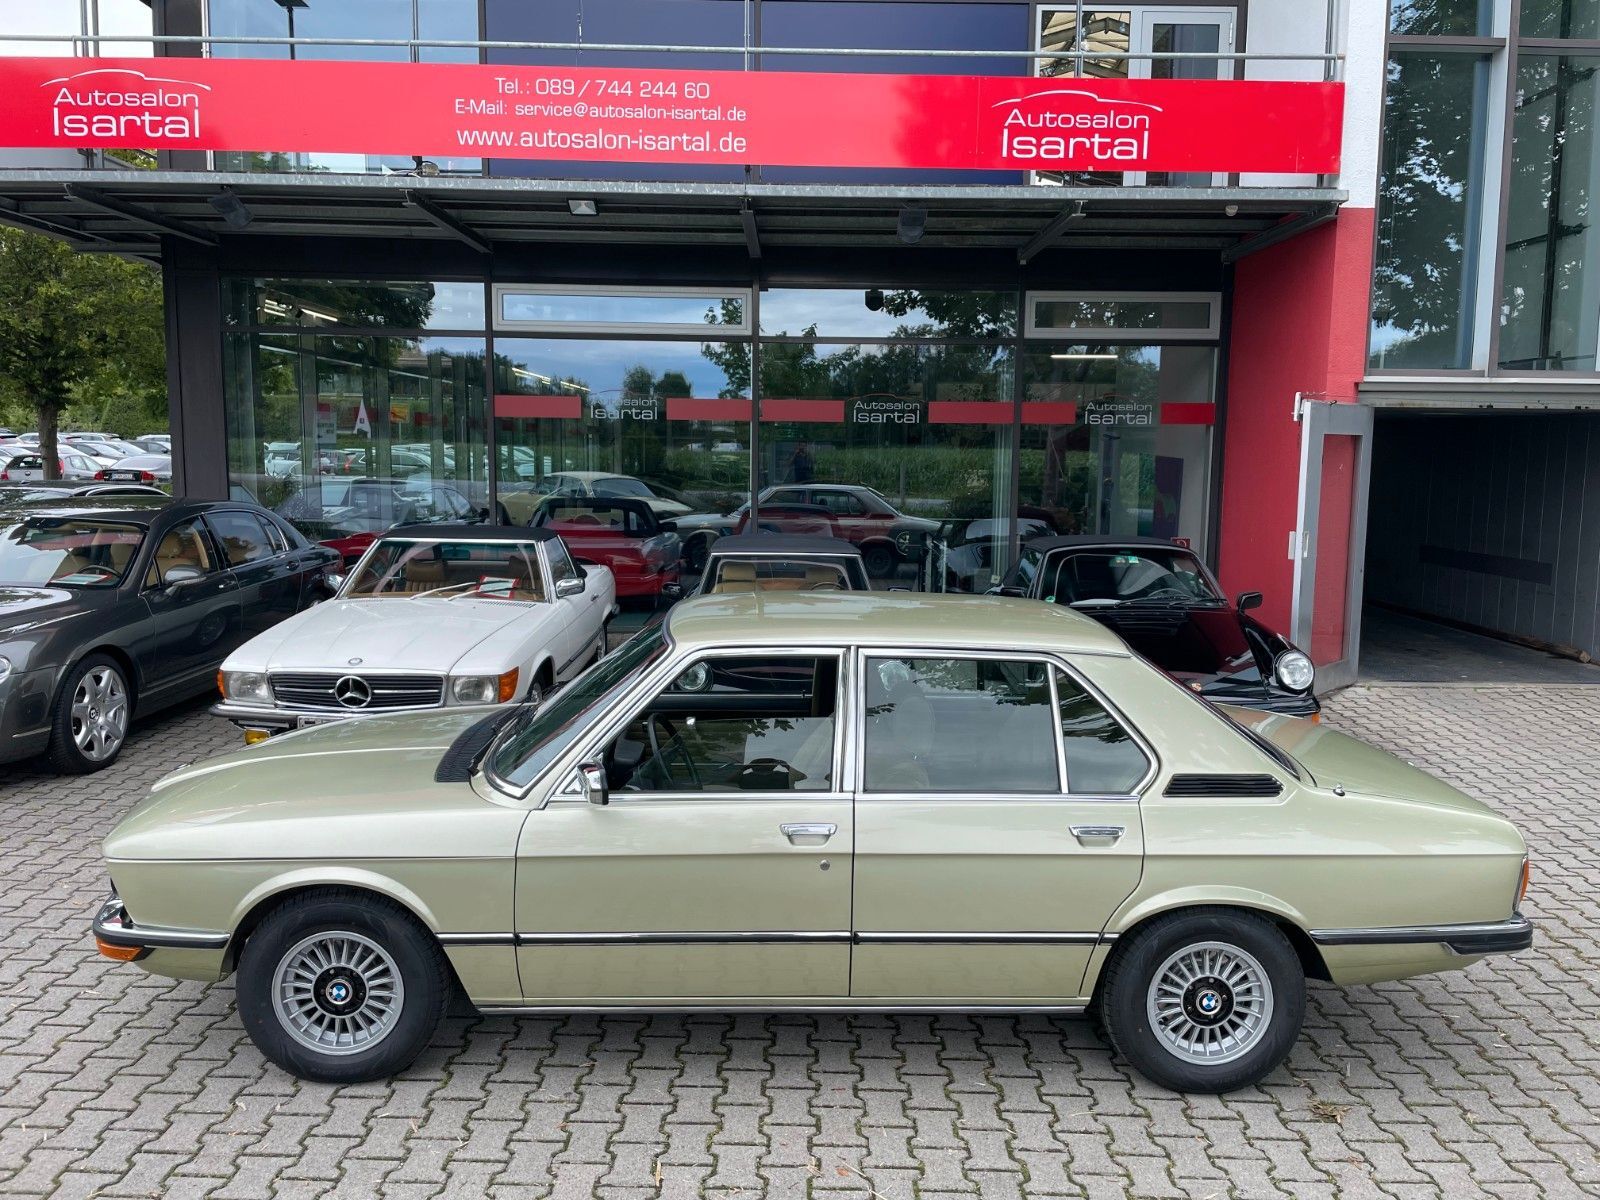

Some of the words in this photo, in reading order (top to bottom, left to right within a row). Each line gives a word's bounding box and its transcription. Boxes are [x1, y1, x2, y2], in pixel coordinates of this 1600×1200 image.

[54, 87, 199, 107] Autosalon
[495, 77, 530, 95] Tel.:
[535, 78, 574, 95] 089
[578, 79, 591, 97] /
[595, 79, 633, 97] 744
[640, 81, 677, 98] 244
[684, 82, 710, 99] 60
[455, 98, 508, 115] E-Mail:
[515, 102, 747, 121] service@autosalon-isartal.de
[1004, 108, 1149, 129] Autosalon
[53, 107, 199, 138] Isartal
[456, 128, 747, 153] www.autosalon-isartal.de
[1002, 129, 1148, 160] Isartal
[590, 406, 657, 420] Isartal
[854, 401, 920, 410] Autosalon
[1085, 402, 1152, 411] Autosalon
[853, 410, 920, 424] Isartal
[1084, 411, 1152, 424] Isartal
